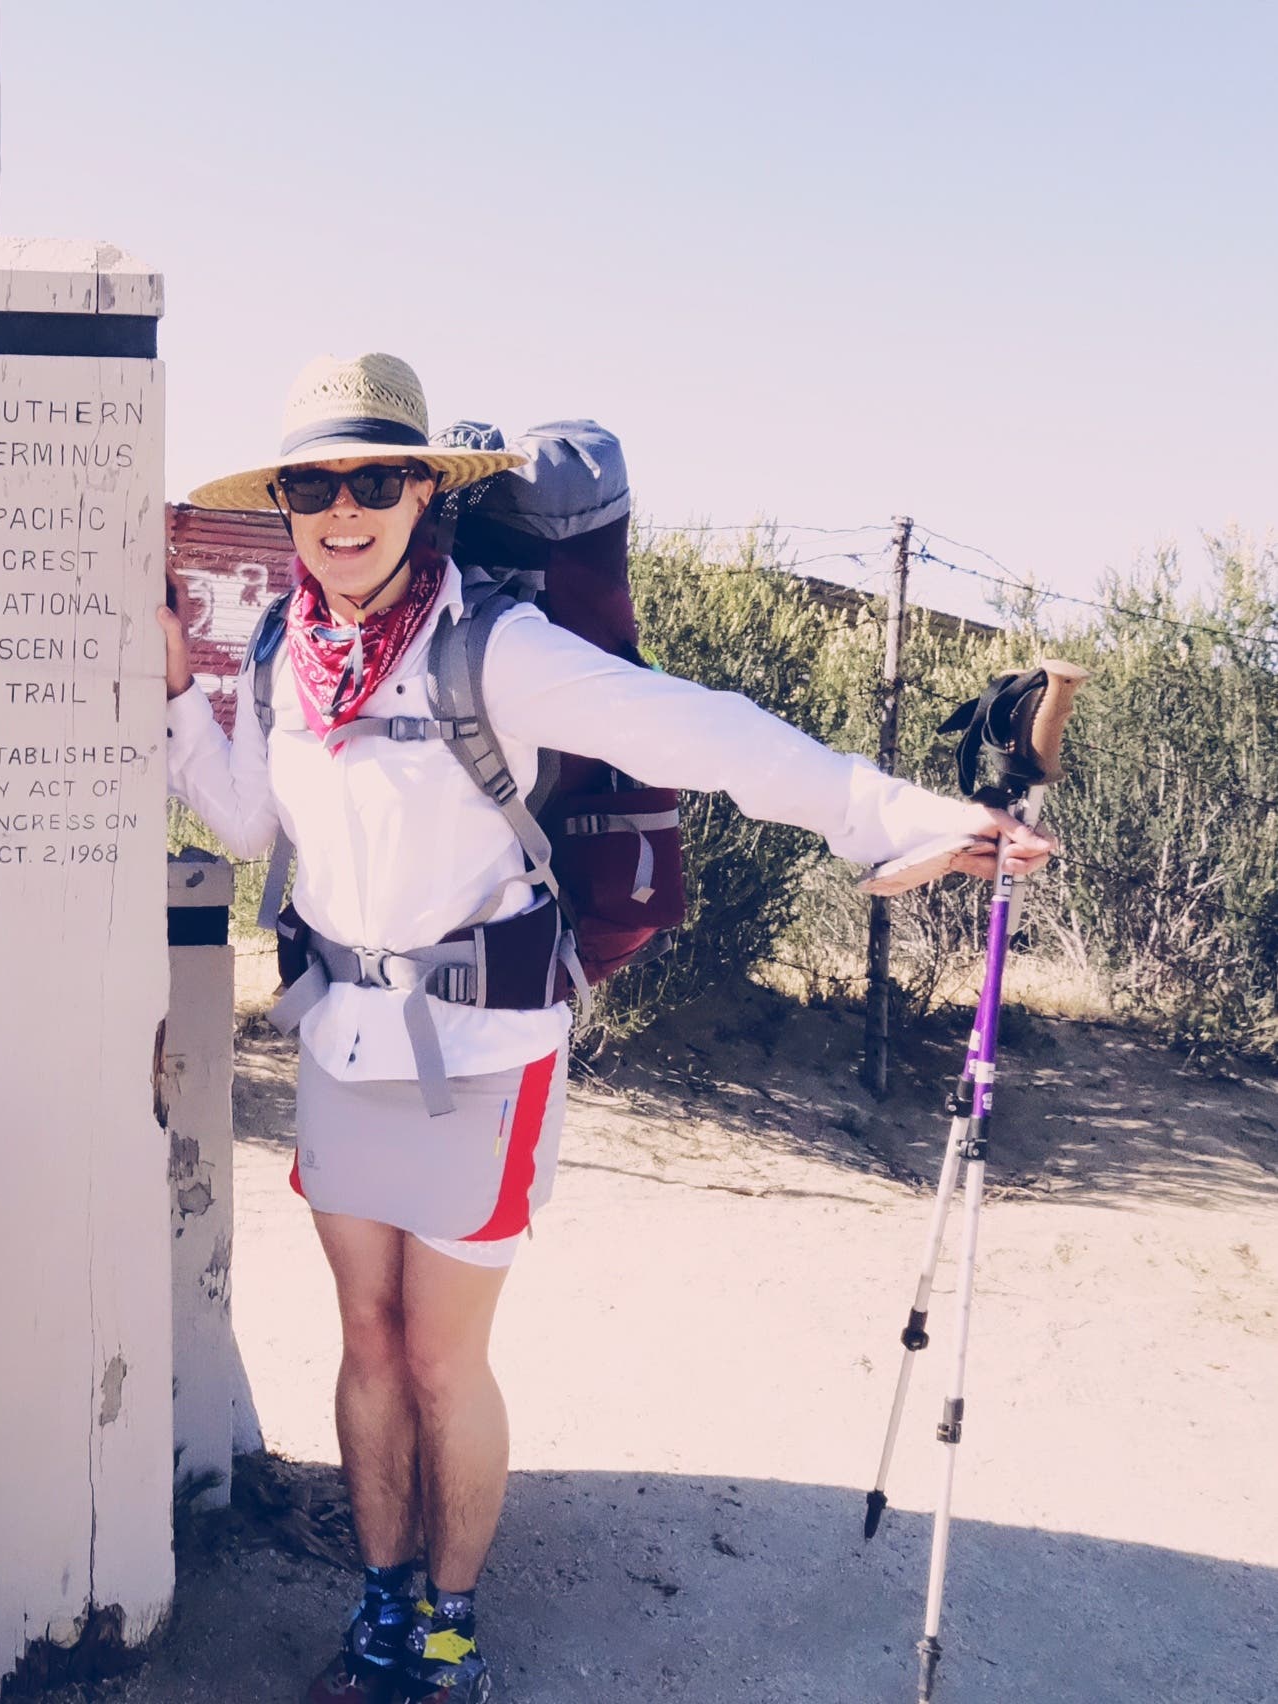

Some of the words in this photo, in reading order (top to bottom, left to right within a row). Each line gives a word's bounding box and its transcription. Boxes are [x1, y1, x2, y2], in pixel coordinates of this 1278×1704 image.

[2, 549, 98, 571] CREST
[6, 682, 87, 704] TRAIL
[29, 780, 77, 797] ACT
[92, 780, 119, 797] OF
[105, 814, 137, 830] ON
